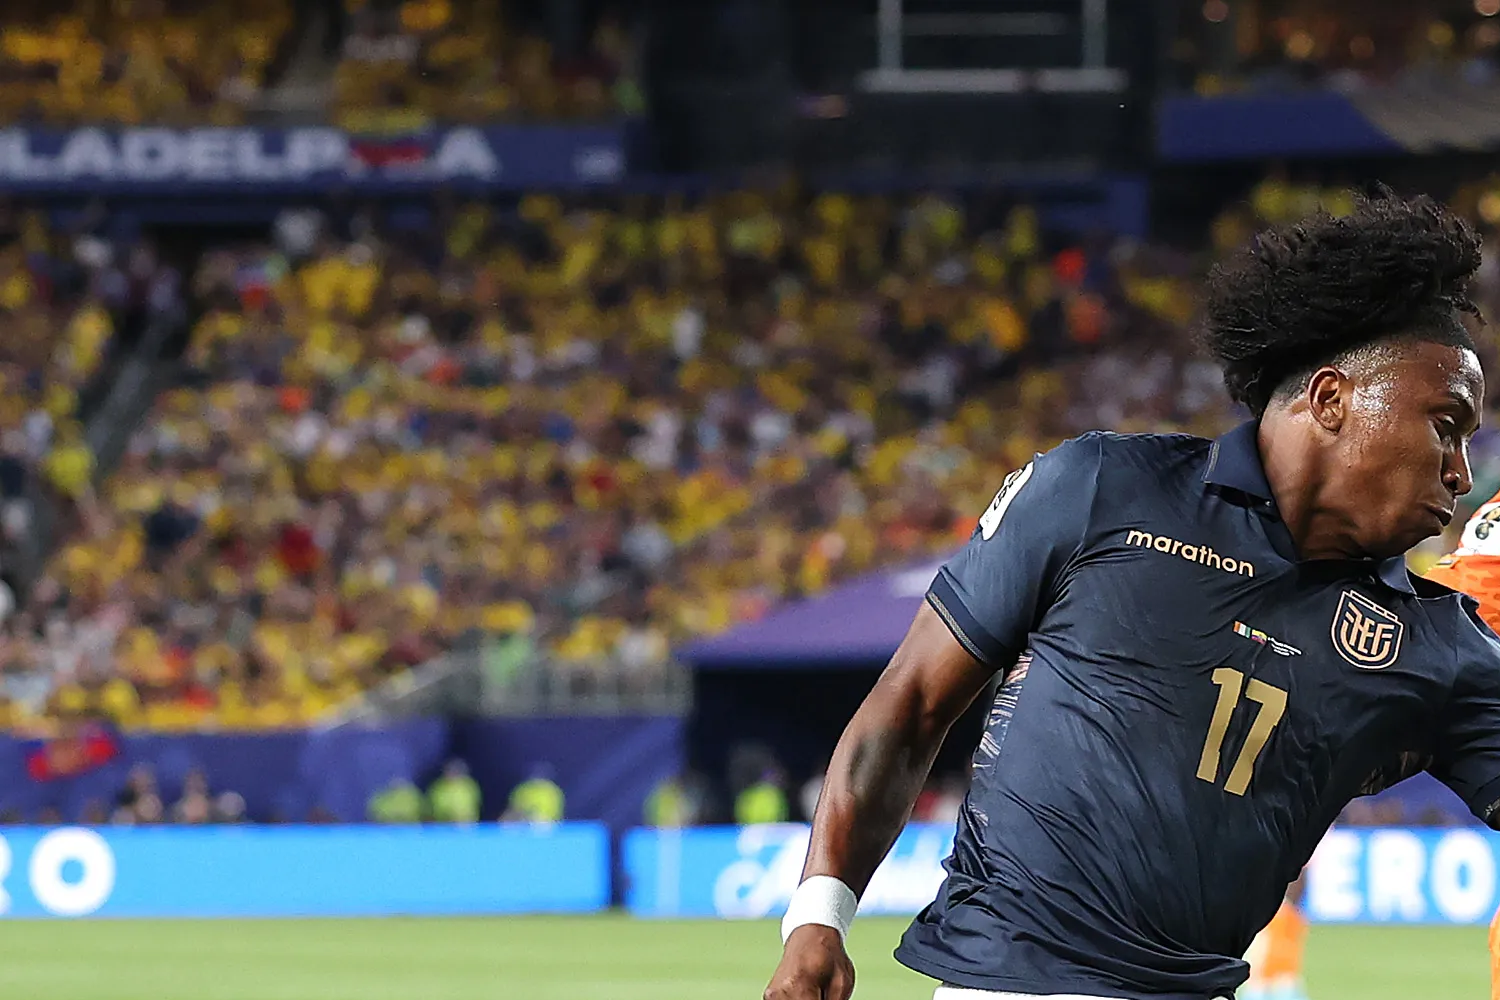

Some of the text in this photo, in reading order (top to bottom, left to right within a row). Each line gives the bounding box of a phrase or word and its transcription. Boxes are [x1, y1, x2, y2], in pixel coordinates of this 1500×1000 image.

[0, 127, 500, 181] LADELPA
[1125, 529, 1254, 578] marathon
[1196, 667, 1288, 796] 17
